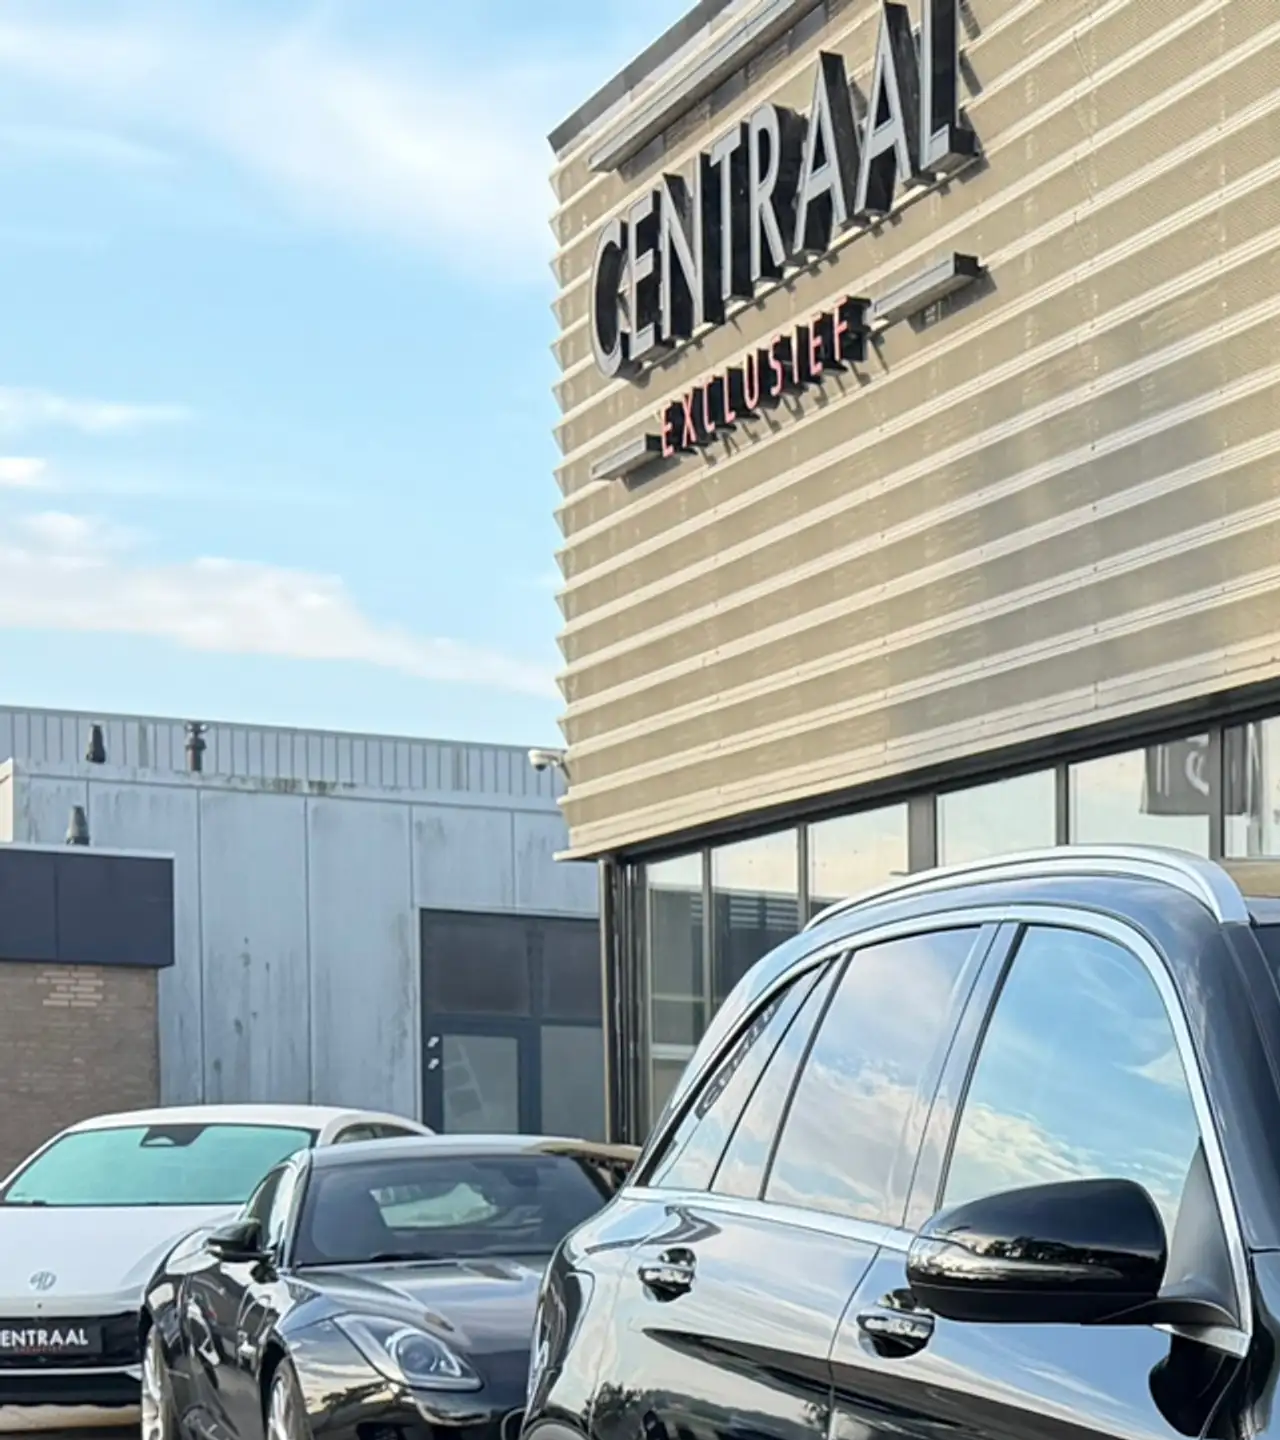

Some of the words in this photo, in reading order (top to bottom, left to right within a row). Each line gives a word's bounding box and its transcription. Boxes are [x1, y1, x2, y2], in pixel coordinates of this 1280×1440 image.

[592, 0, 962, 377] CENTRAAL
[661, 295, 852, 458] EXCLUSIEF
[0, 1328, 89, 1347] ENTRAAL
